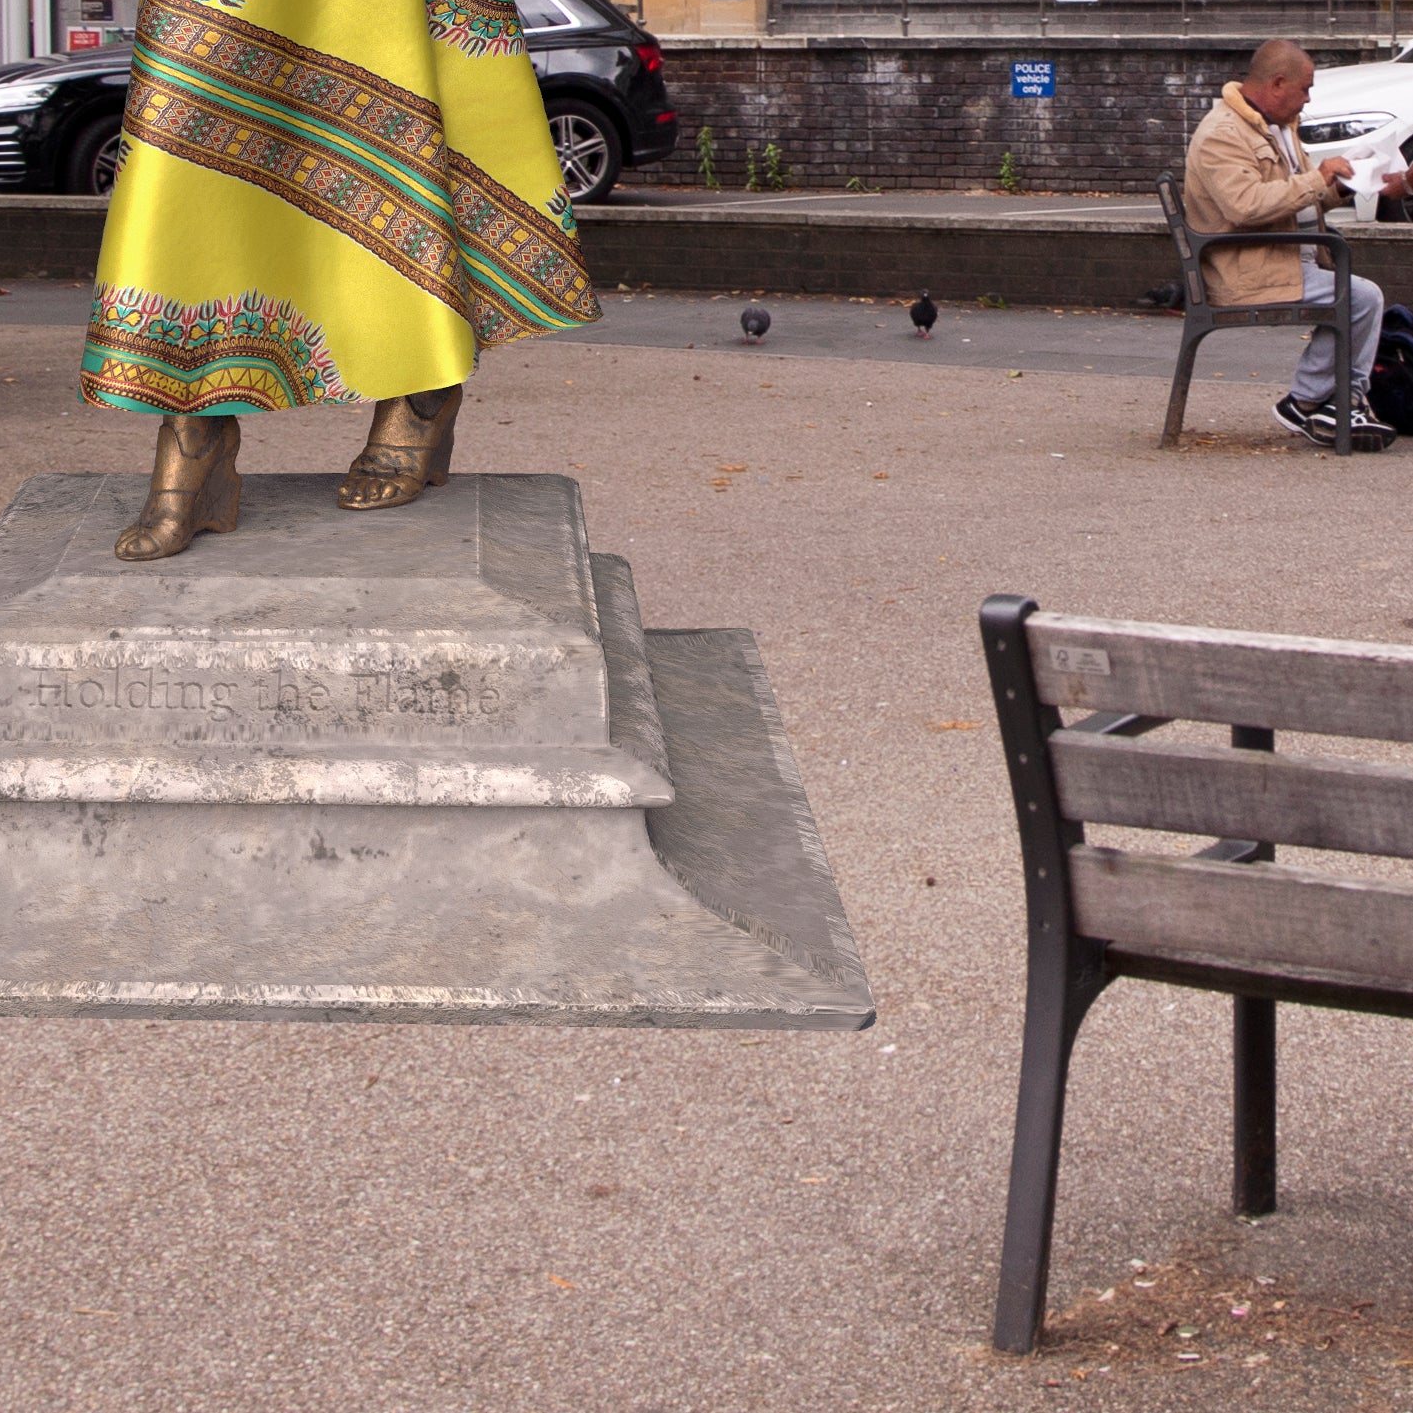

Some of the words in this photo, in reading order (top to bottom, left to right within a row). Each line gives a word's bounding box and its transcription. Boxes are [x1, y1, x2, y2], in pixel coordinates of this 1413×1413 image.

[1015, 63, 1052, 74] POLICE
[1016, 73, 1050, 84] vehicle
[1022, 84, 1043, 95] only
[28, 667, 241, 722] Holding
[255, 669, 332, 712] the
[349, 670, 502, 715] Flame
